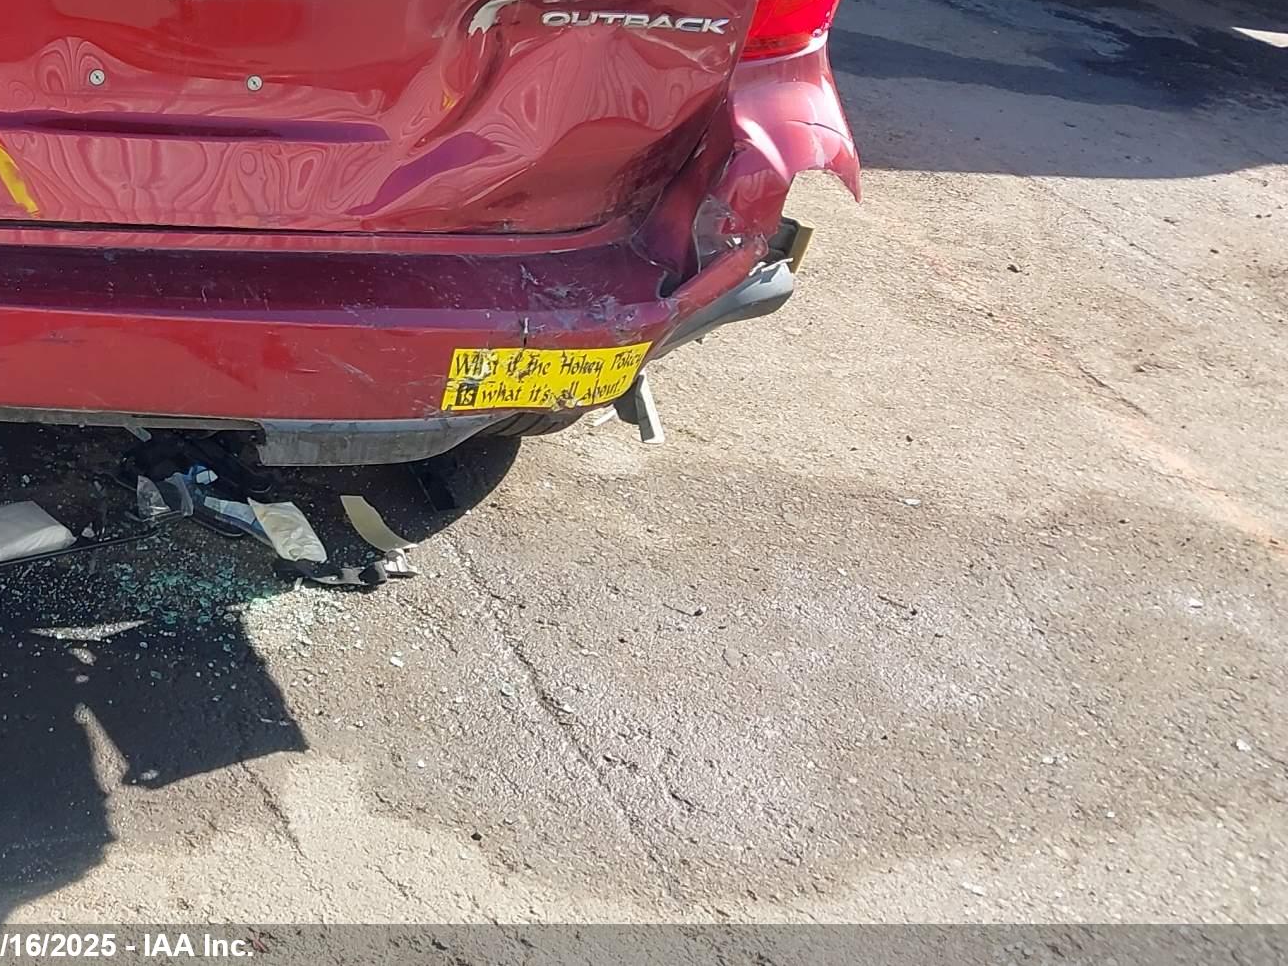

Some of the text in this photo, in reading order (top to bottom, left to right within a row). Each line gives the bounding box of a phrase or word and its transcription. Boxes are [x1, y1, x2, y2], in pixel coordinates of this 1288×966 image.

[541, 10, 729, 35] OUTBACK
[459, 388, 474, 405] is
[482, 381, 522, 403] what
[528, 383, 550, 402] it's
